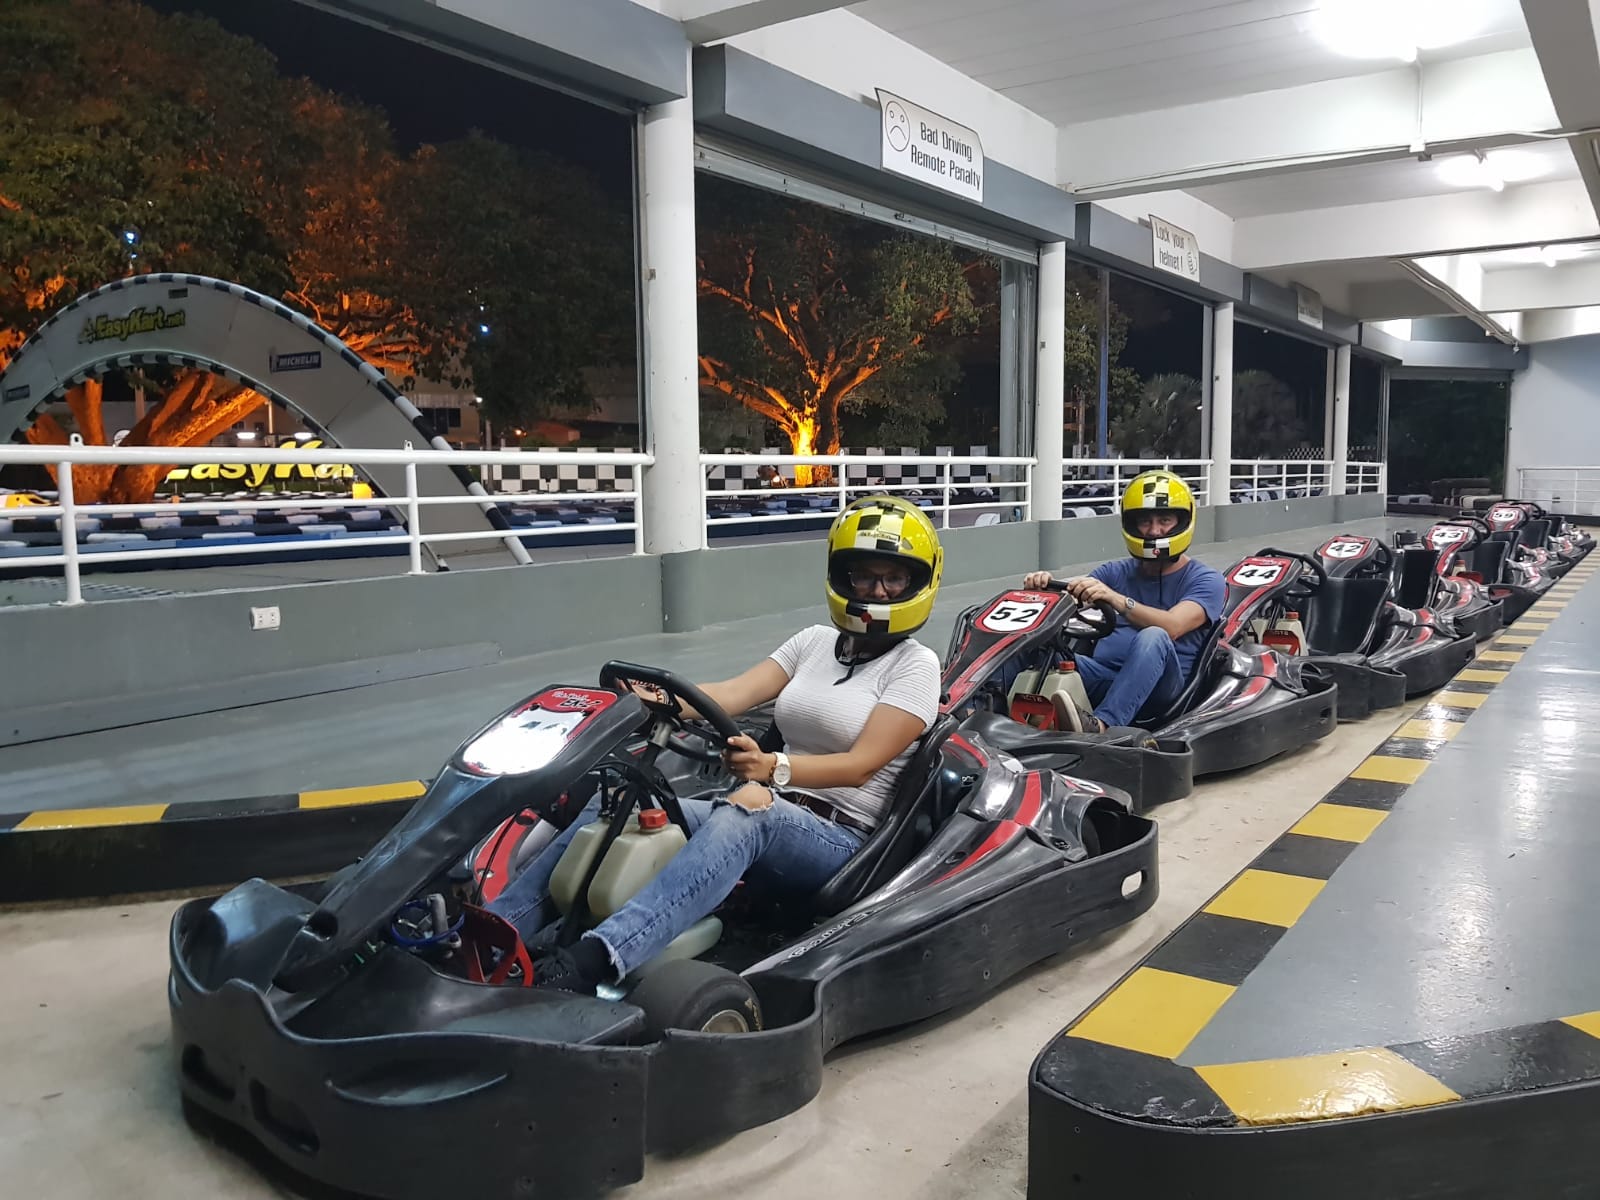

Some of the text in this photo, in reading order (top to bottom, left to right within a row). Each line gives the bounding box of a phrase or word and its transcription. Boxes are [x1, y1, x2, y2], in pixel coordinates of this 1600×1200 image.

[920, 121, 972, 162] Bad Driving
[911, 144, 981, 191] Remote Penalty
[1155, 221, 1170, 243] Lock
[1435, 531, 1462, 540] 43
[1330, 544, 1361, 553] 42
[1239, 568, 1278, 579] 44
[990, 606, 1040, 623] 52
